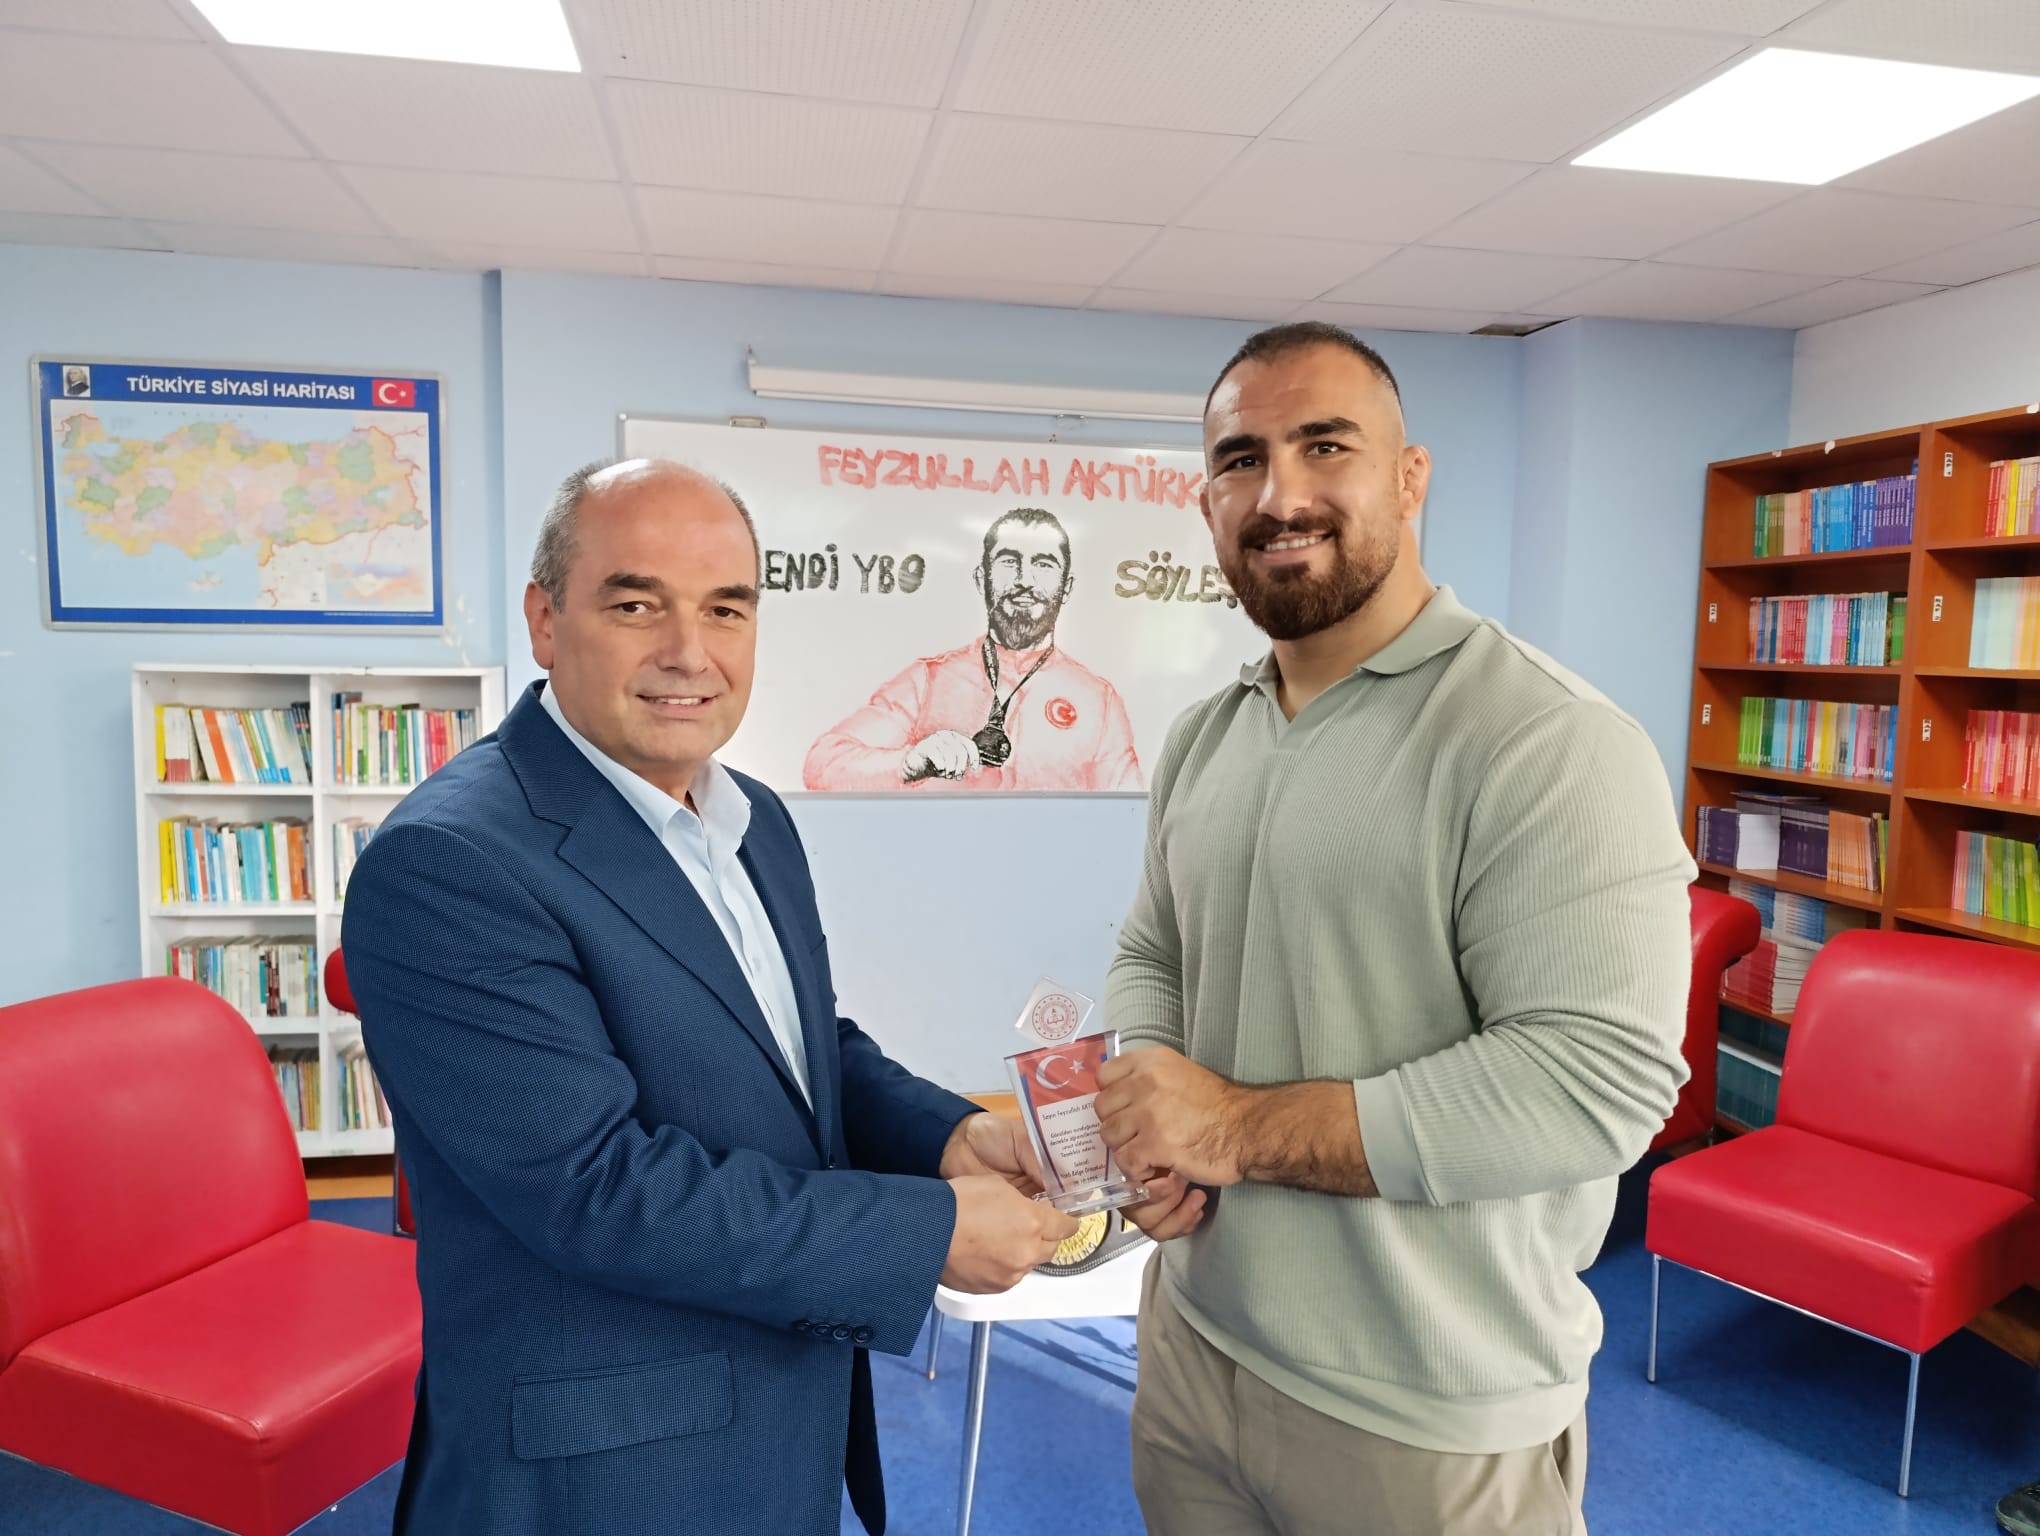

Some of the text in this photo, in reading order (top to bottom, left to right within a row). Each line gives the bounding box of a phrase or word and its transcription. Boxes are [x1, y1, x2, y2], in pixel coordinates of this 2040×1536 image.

[126, 375, 355, 400] TÜRKİYE SİYASİ HARİTASI
[817, 444, 1204, 508] FEYZULLAH AKTÜRK
[760, 543, 926, 594] ENDİ YBO
